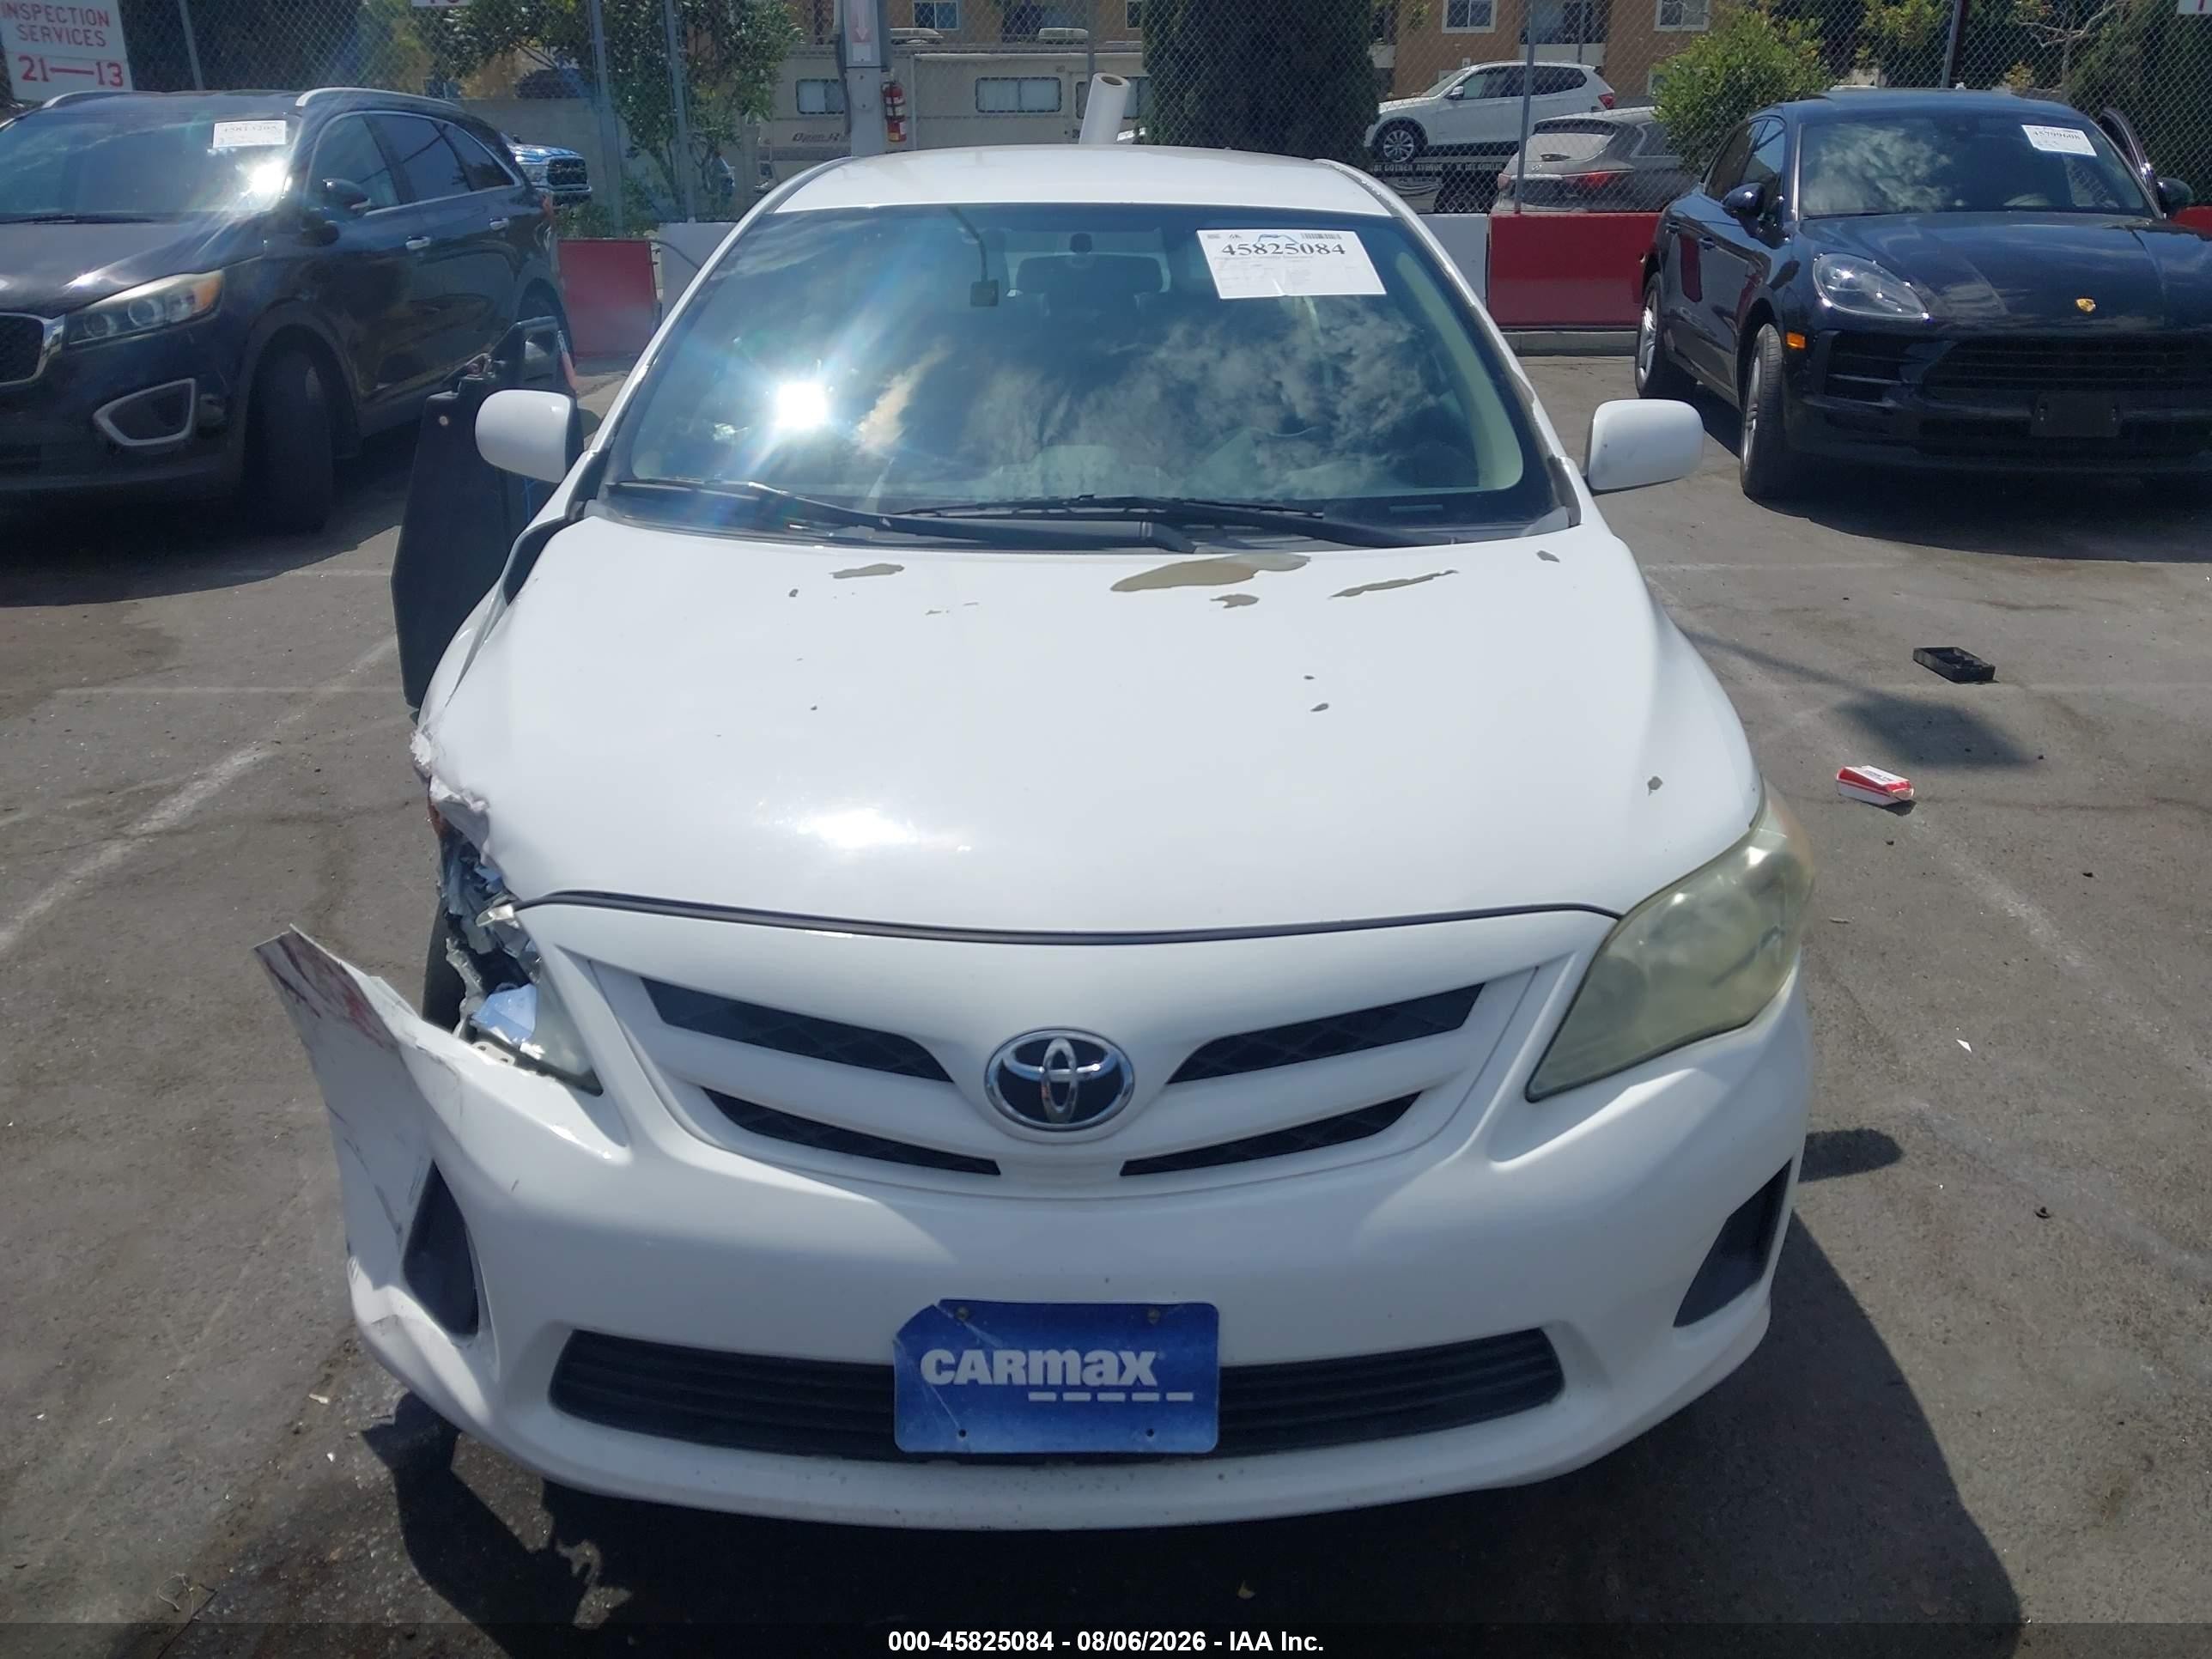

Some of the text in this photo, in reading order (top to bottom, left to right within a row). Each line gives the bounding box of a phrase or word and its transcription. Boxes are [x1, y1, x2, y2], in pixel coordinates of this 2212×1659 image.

[1, 3, 110, 27] INSPECTION
[16, 23, 106, 47] SERVICES
[1222, 242, 1346, 256] 45825084
